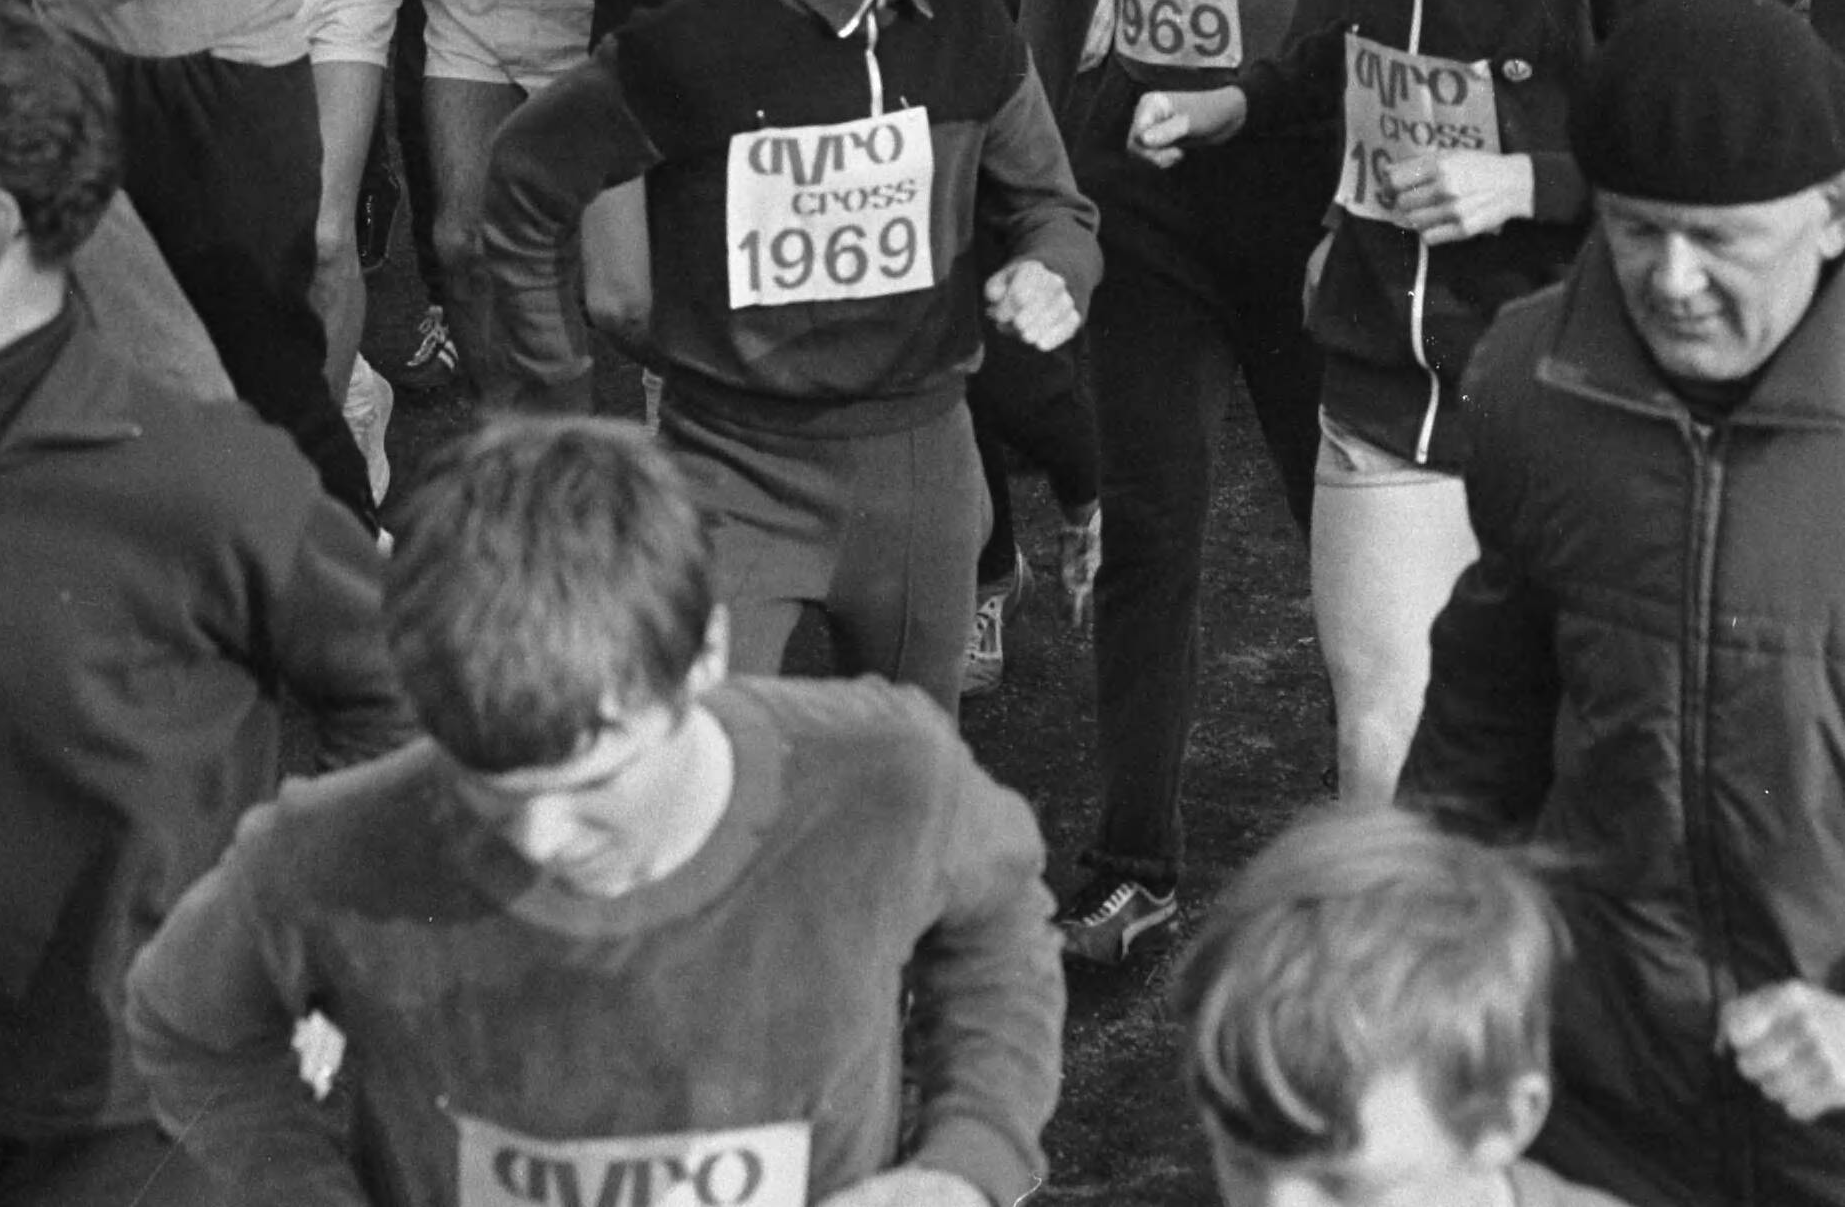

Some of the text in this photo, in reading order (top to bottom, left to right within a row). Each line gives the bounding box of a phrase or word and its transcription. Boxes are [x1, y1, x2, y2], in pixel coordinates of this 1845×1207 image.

[1357, 49, 1468, 108] avro
[748, 124, 903, 185] avro
[1380, 113, 1485, 150] cross
[792, 179, 918, 216] cross
[1352, 141, 1399, 210] 19
[739, 216, 918, 292] 1969
